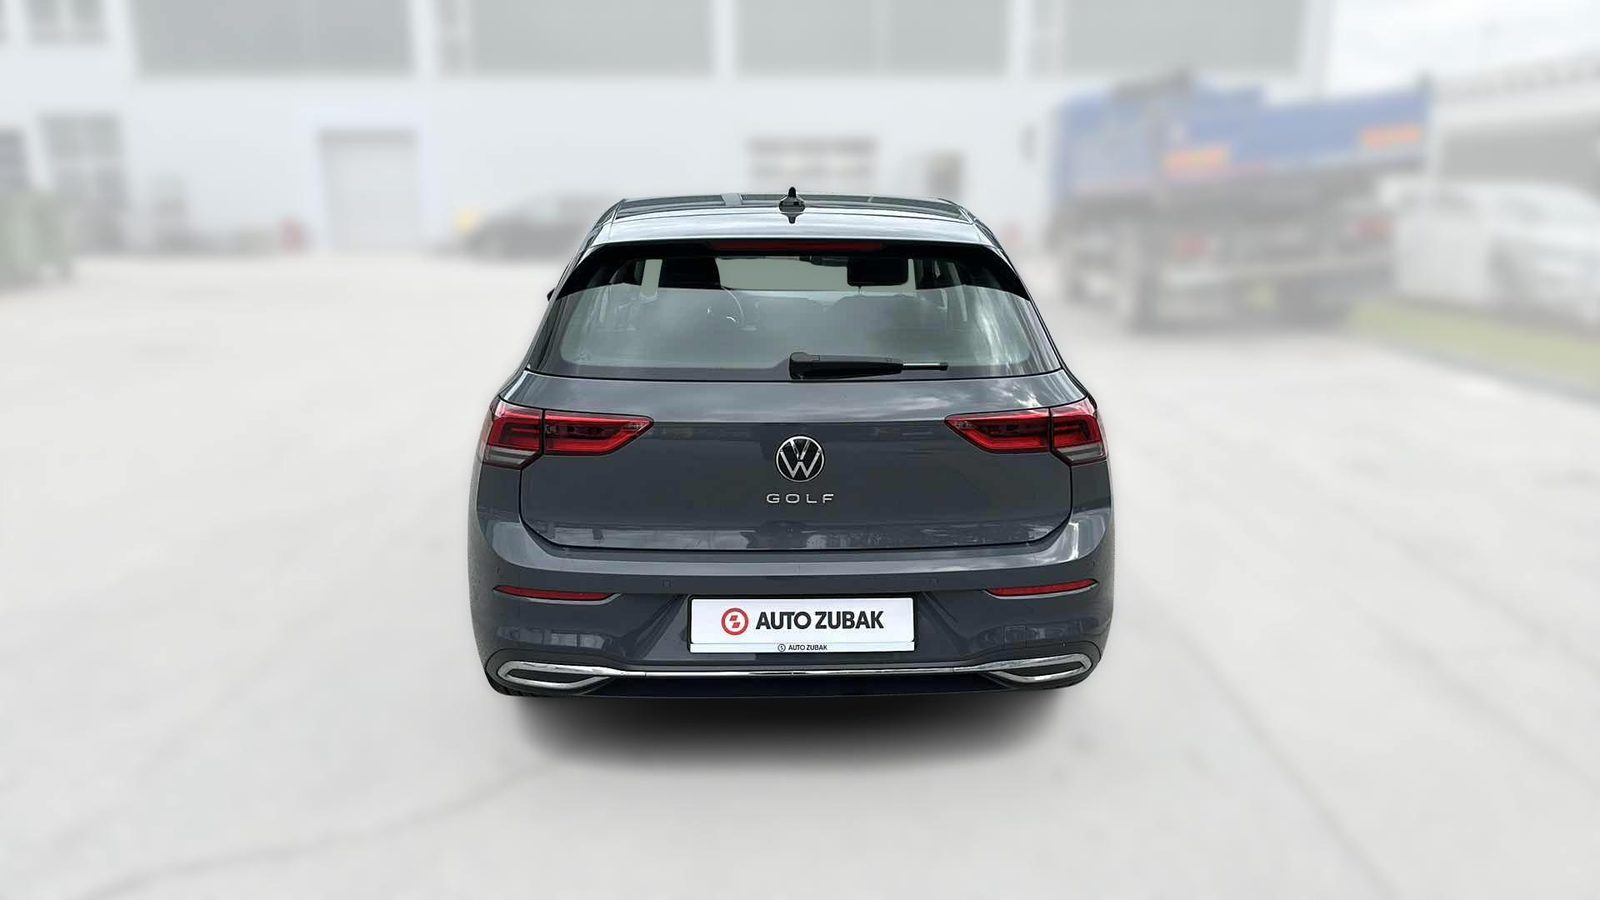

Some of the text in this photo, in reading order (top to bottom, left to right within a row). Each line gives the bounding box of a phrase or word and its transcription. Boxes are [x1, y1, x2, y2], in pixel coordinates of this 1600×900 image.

[777, 437, 823, 480] VW
[766, 493, 834, 504] GOLF
[755, 611, 884, 630] AUTO ZUBAK
